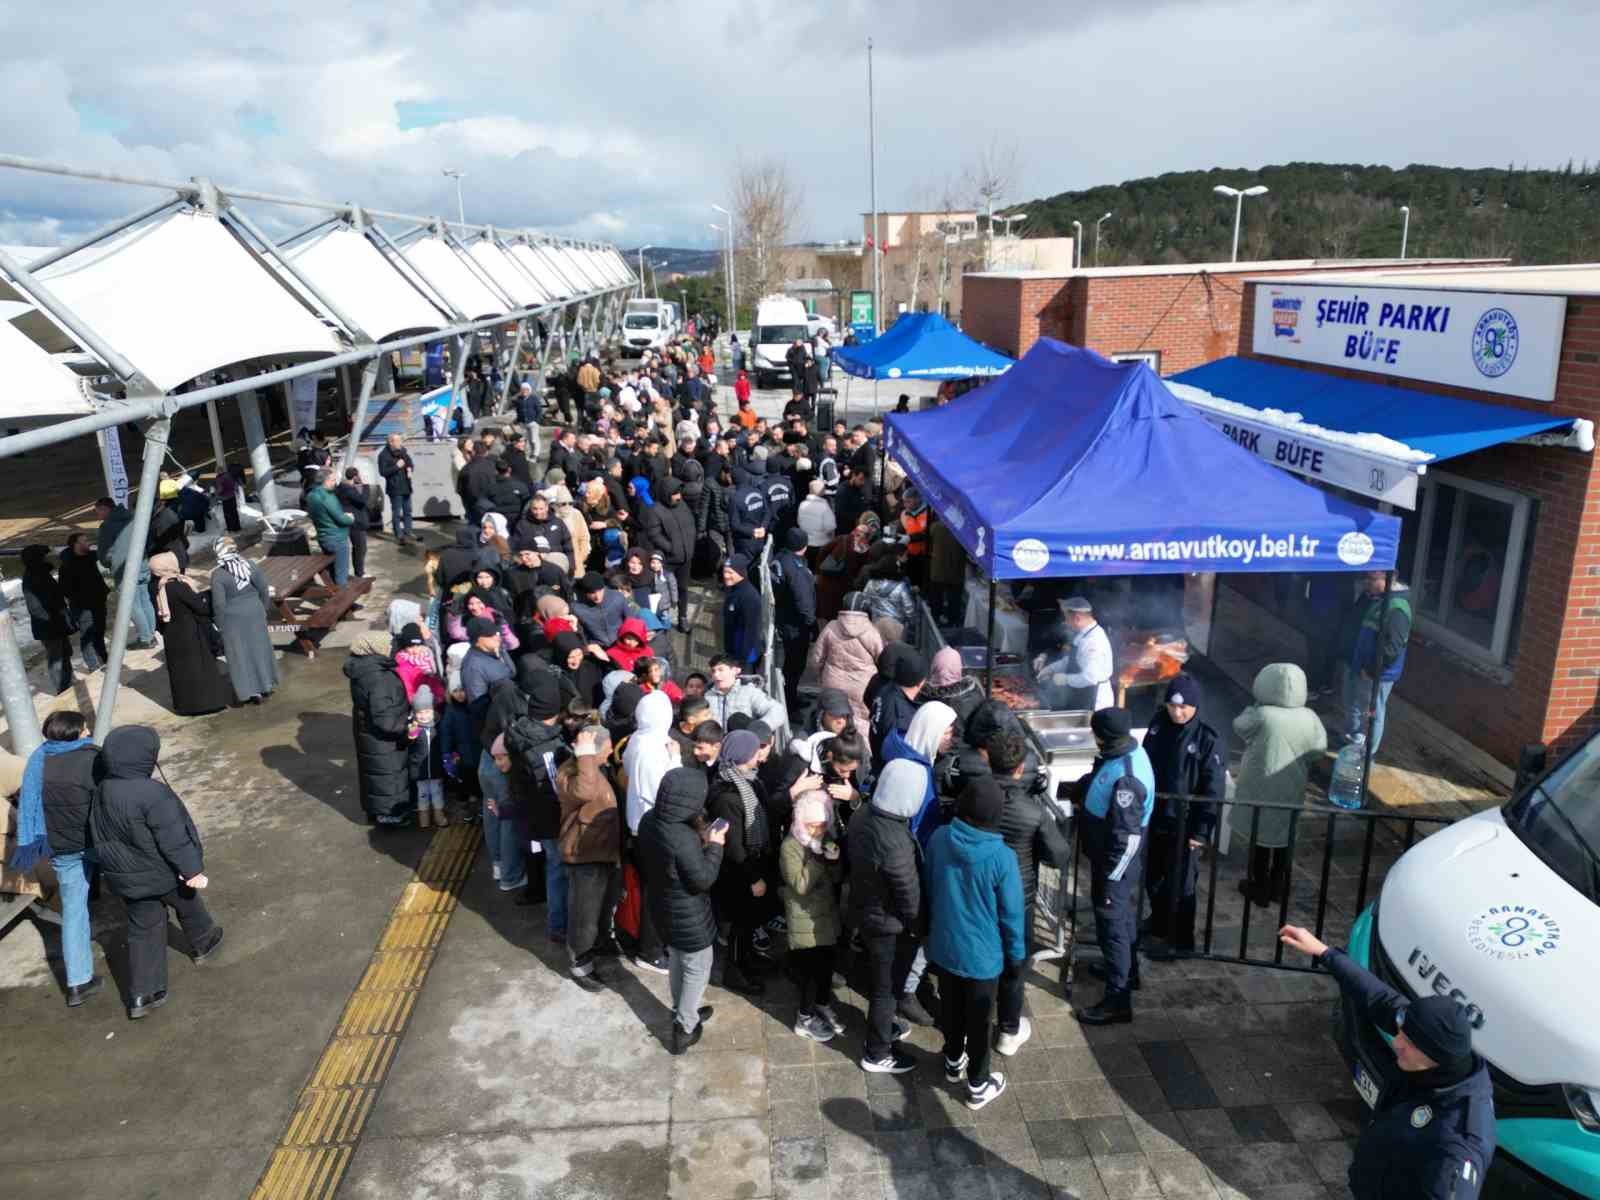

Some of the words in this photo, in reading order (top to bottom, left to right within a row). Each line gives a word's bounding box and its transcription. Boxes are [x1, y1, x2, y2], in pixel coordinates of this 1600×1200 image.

[1316, 295, 1369, 328] ŞEHİR
[1378, 302, 1450, 333] PARKI
[1344, 330, 1400, 364] BÜFE
[1275, 439, 1325, 473] BÜFE
[1067, 534, 1319, 563] www.arnavutkoy.bel.tr
